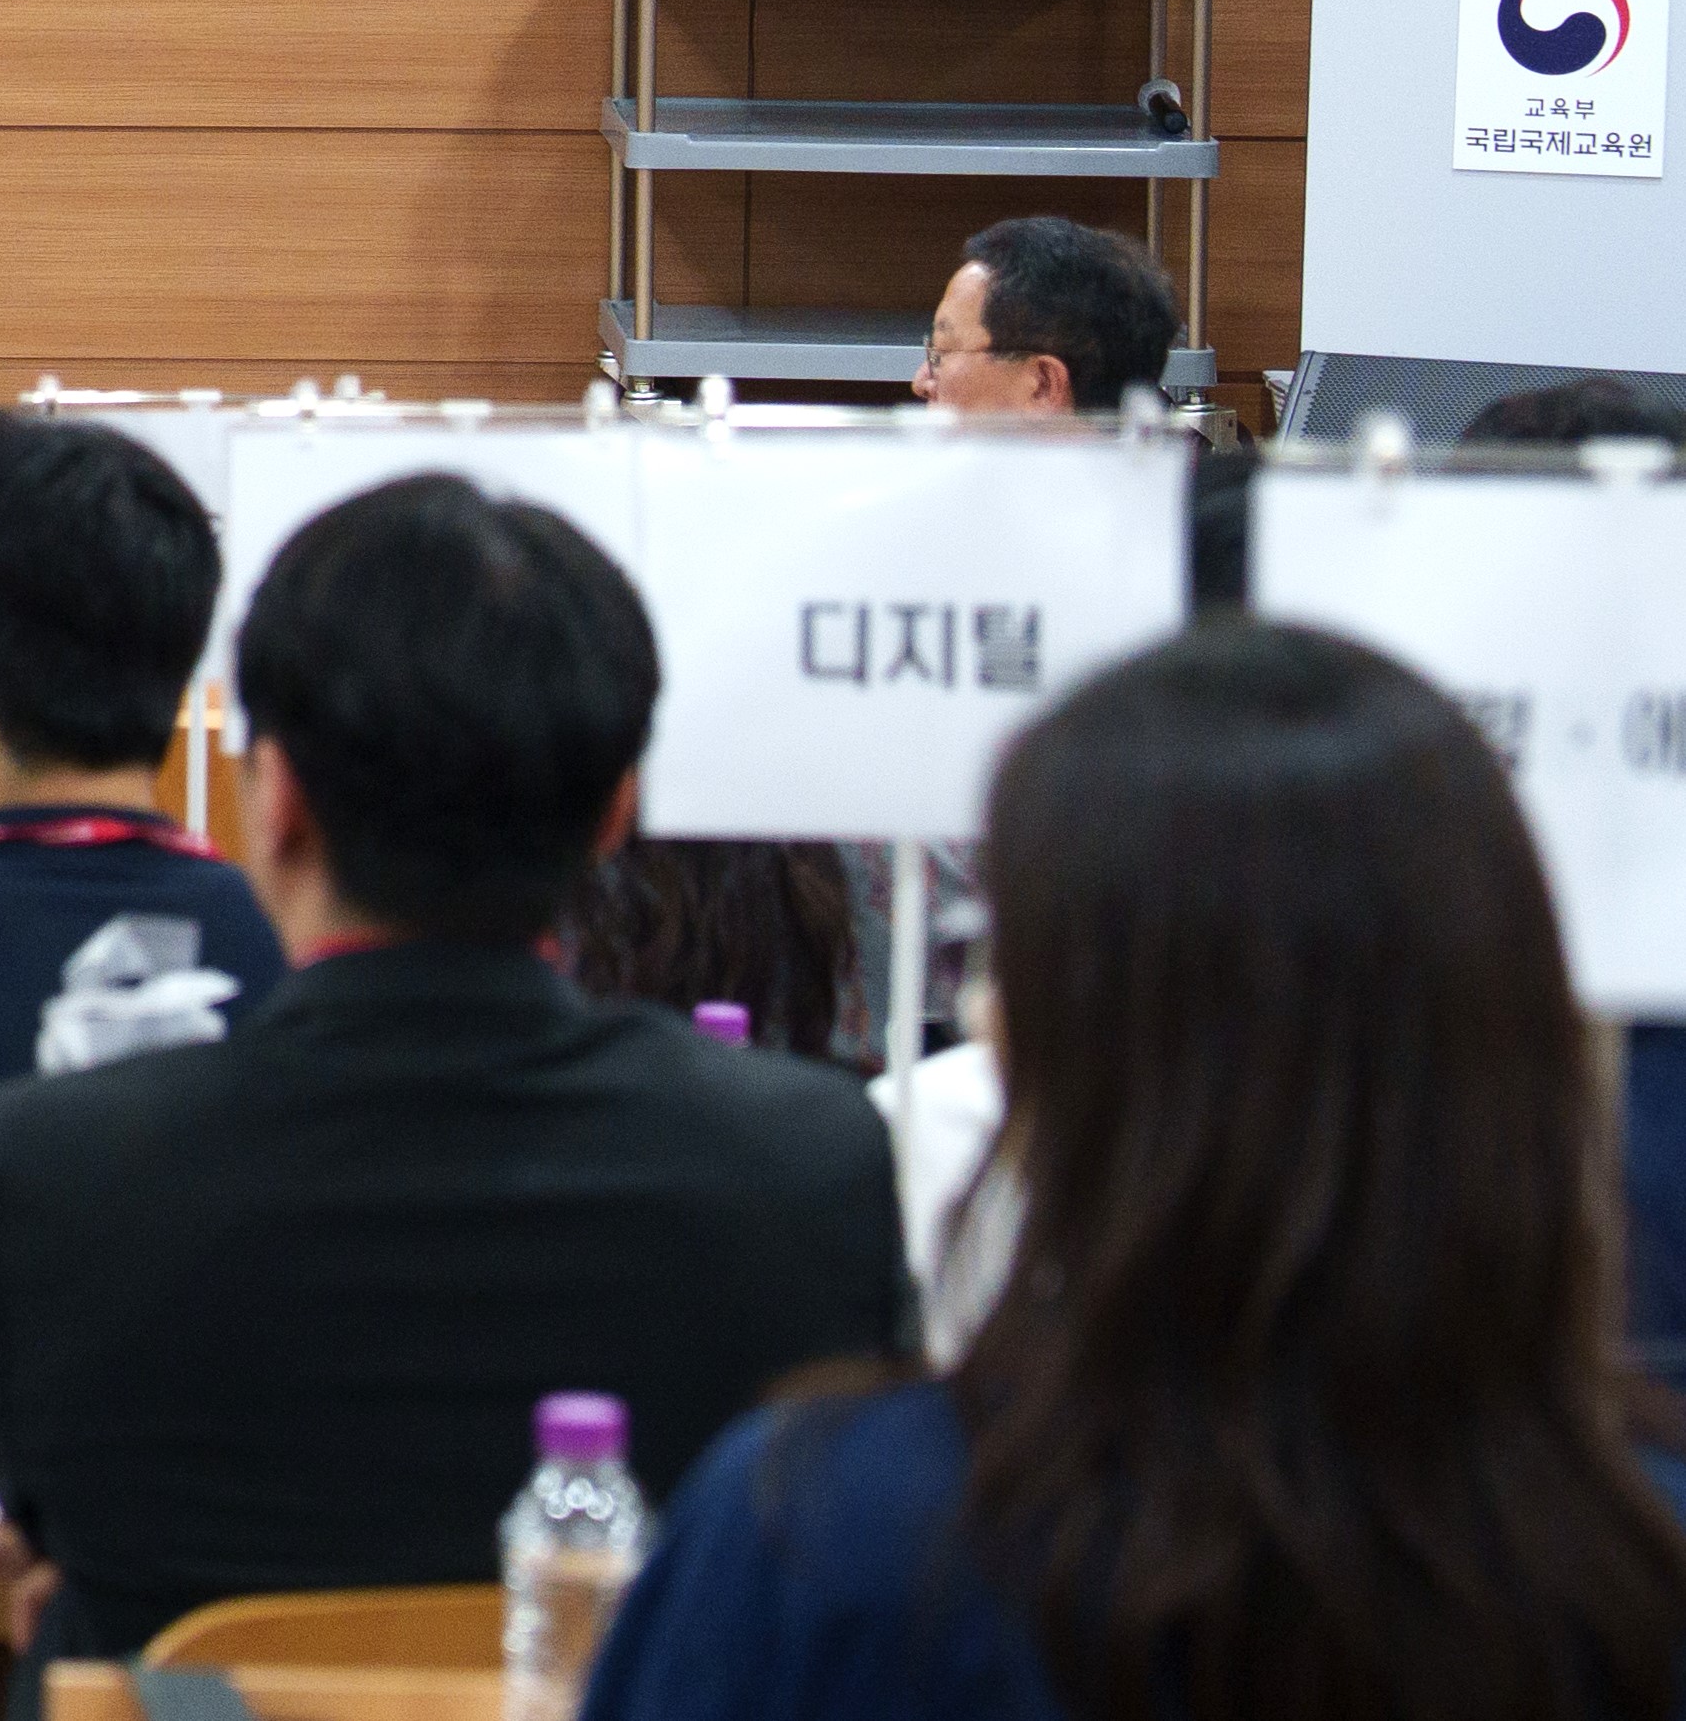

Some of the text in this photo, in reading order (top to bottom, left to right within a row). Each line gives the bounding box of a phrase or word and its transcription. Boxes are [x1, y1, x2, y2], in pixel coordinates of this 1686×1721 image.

[1524, 97, 1596, 120] 교육부
[1465, 127, 1653, 159] 국립국제교육원
[797, 599, 1042, 693] 디지털
